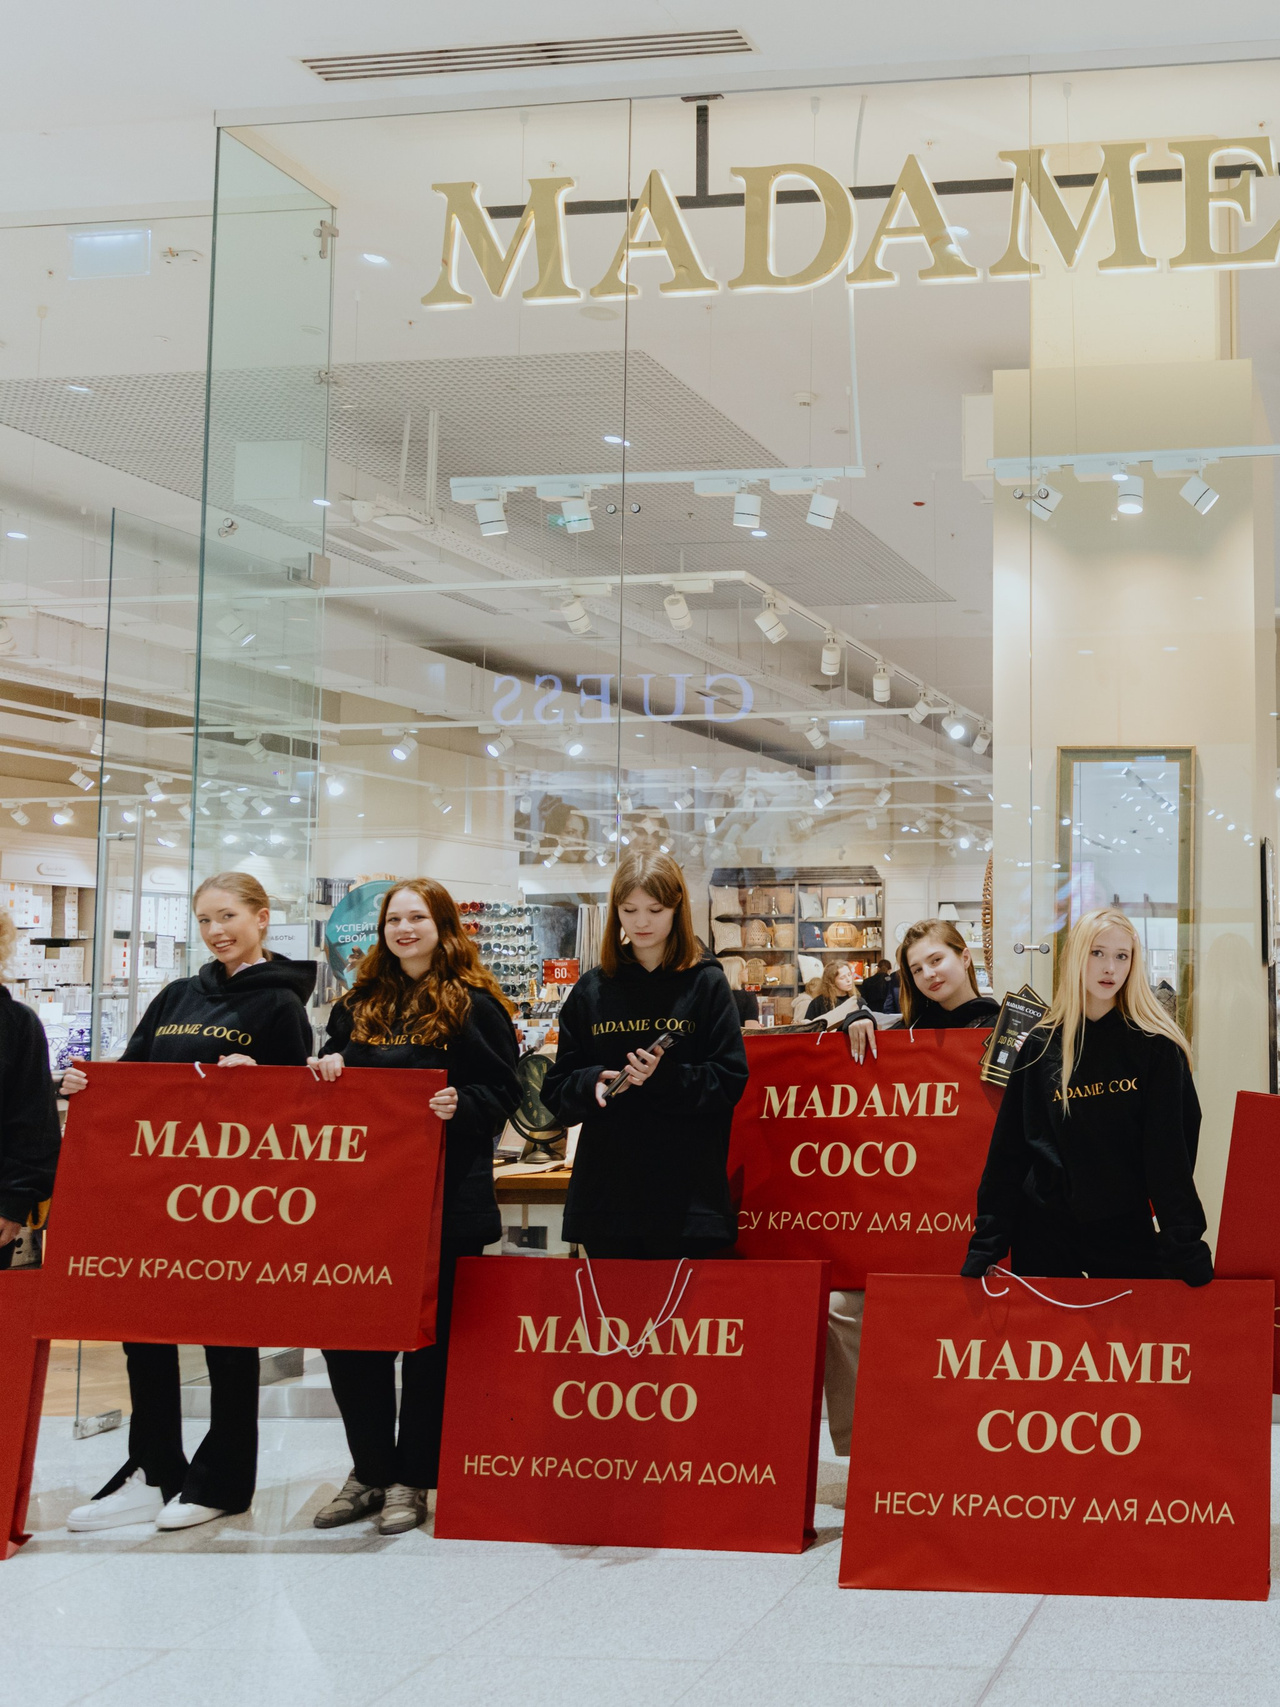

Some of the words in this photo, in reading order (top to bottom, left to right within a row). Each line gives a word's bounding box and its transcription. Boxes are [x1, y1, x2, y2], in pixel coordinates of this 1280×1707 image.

[338, 932, 366, 943] СВОЙ
[554, 967, 567, 979] 60
[654, 1017, 696, 1034] COCO
[1025, 1008, 1042, 1018] COCO
[202, 1025, 252, 1046] COCO
[760, 1082, 959, 1118] MADAME
[1052, 1081, 1105, 1103] ADAME
[1107, 1076, 1139, 1094] COC
[130, 1120, 367, 1162] MADAME
[790, 1142, 916, 1177] COCO
[167, 1184, 316, 1225] COCO
[738, 1211, 762, 1229] СУ
[769, 1212, 862, 1230] КРАСОТУ
[867, 1213, 911, 1233] ДЛЯ
[68, 1256, 133, 1277] НЕСУ
[140, 1258, 252, 1281] КРАСОТУ
[256, 1263, 307, 1284] ДЛЯ
[313, 1264, 392, 1286] ДОМА
[514, 1315, 744, 1357] MADAME
[933, 1339, 1191, 1384] MADAME
[553, 1381, 697, 1422] COCO
[977, 1410, 1141, 1455] COCO
[465, 1455, 524, 1476] НЕСУ
[531, 1457, 638, 1480] КРАСОТУ
[643, 1461, 692, 1483] ДЛЯ
[698, 1462, 776, 1485] ДОМА
[875, 1492, 944, 1516] НЕСУ
[953, 1494, 1076, 1520] КРАСОТУ
[1083, 1498, 1137, 1523] ДЛЯ
[1146, 1500, 1234, 1525] ДОМА
